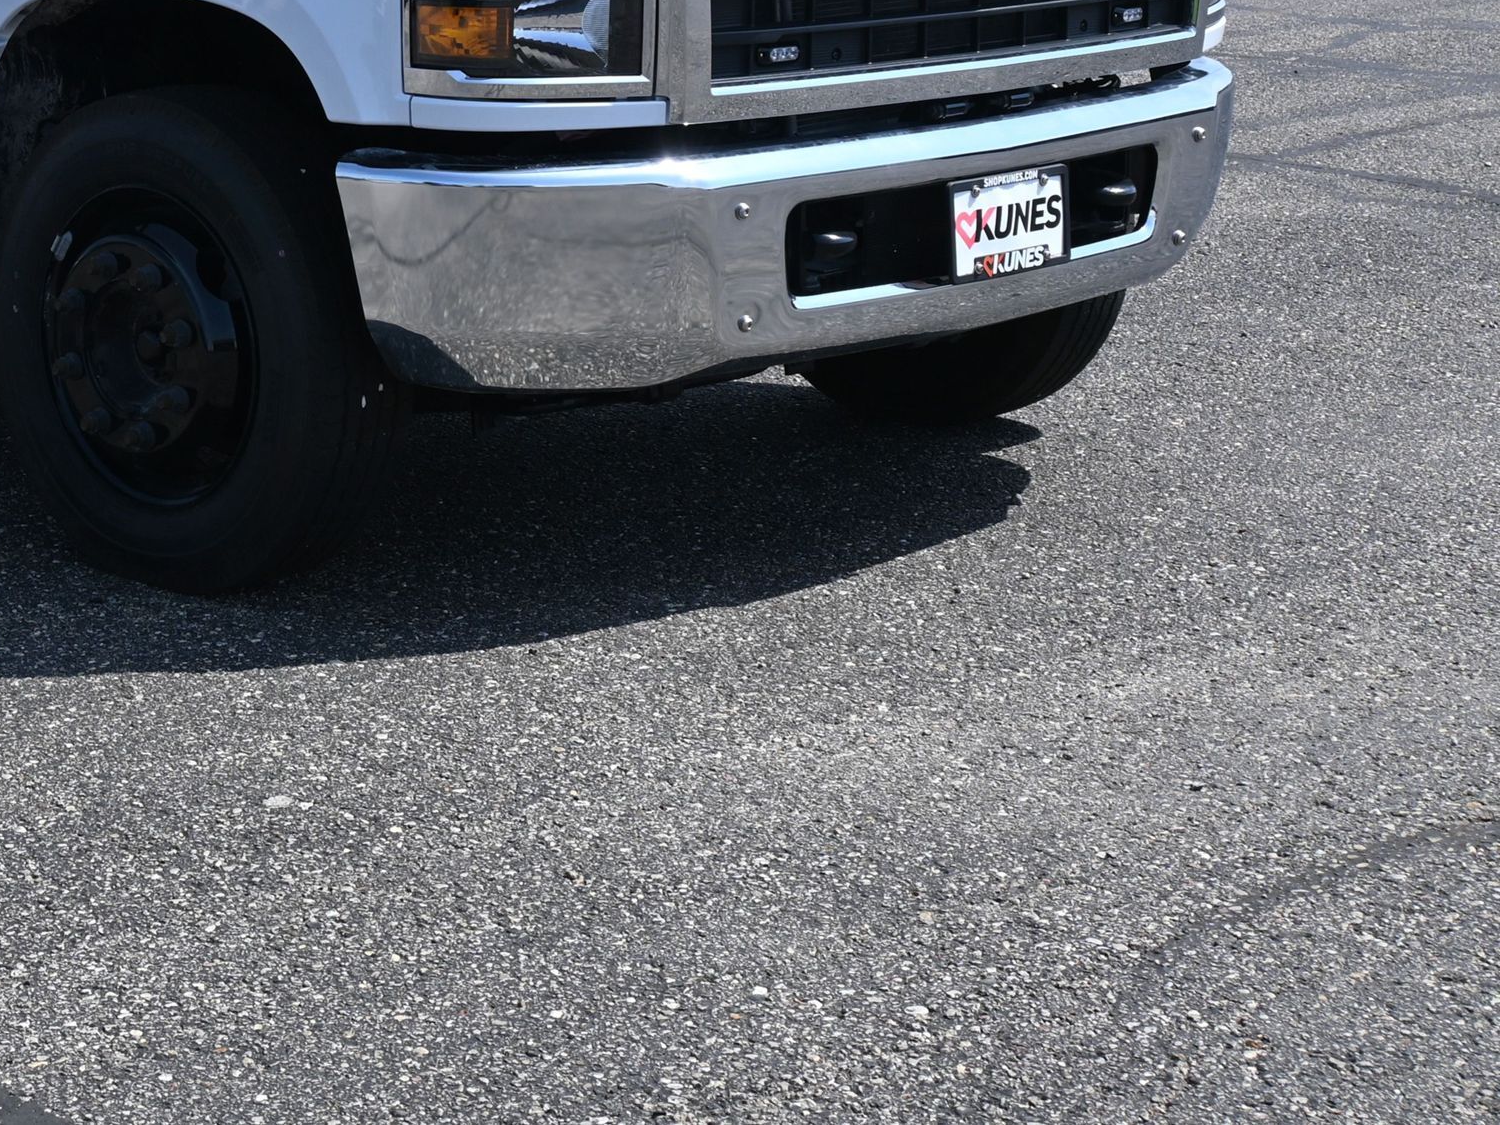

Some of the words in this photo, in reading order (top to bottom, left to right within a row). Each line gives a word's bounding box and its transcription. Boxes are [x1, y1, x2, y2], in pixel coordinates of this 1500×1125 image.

[983, 169, 1038, 188] SHOPKUNES.COM
[974, 194, 1062, 243] KUNES
[992, 245, 1045, 275] KUNES
